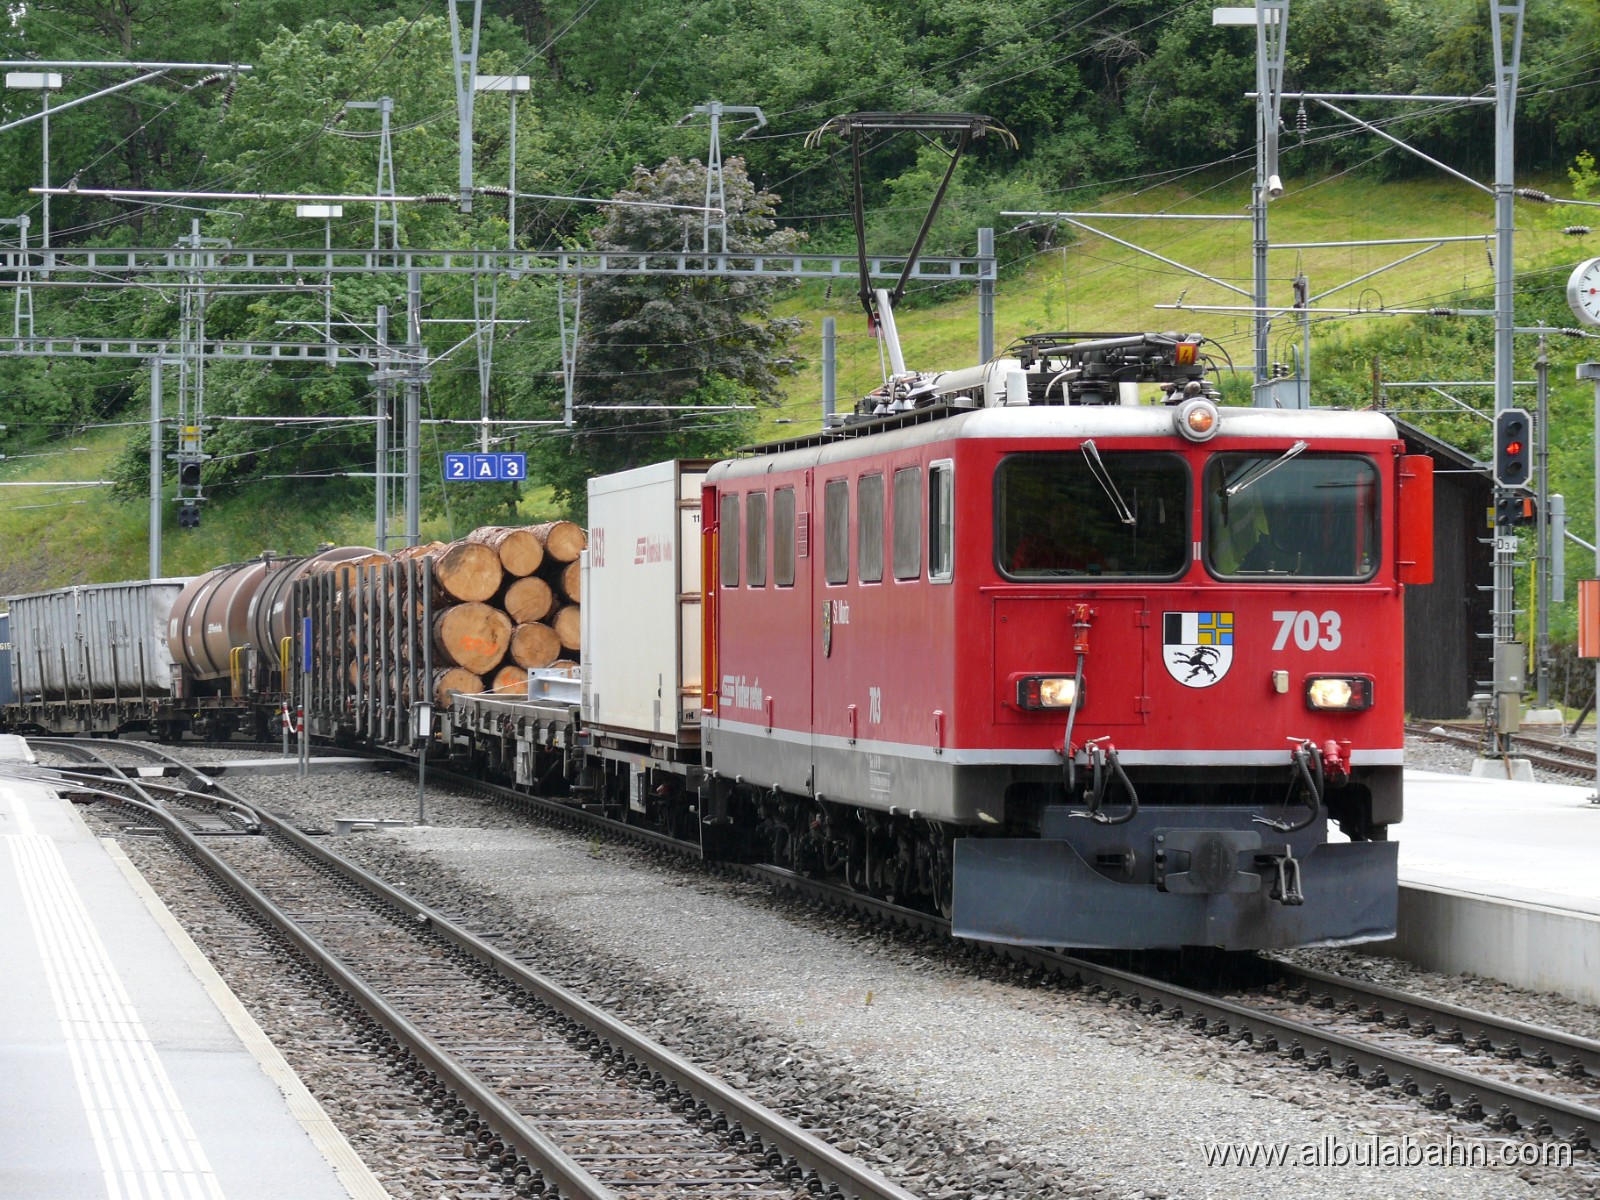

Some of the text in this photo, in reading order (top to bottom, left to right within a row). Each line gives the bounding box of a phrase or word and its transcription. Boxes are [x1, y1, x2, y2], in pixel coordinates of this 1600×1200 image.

[453, 462, 518, 476] 2 A 3
[1271, 610, 1342, 651] 703
[869, 687, 881, 724] 703
